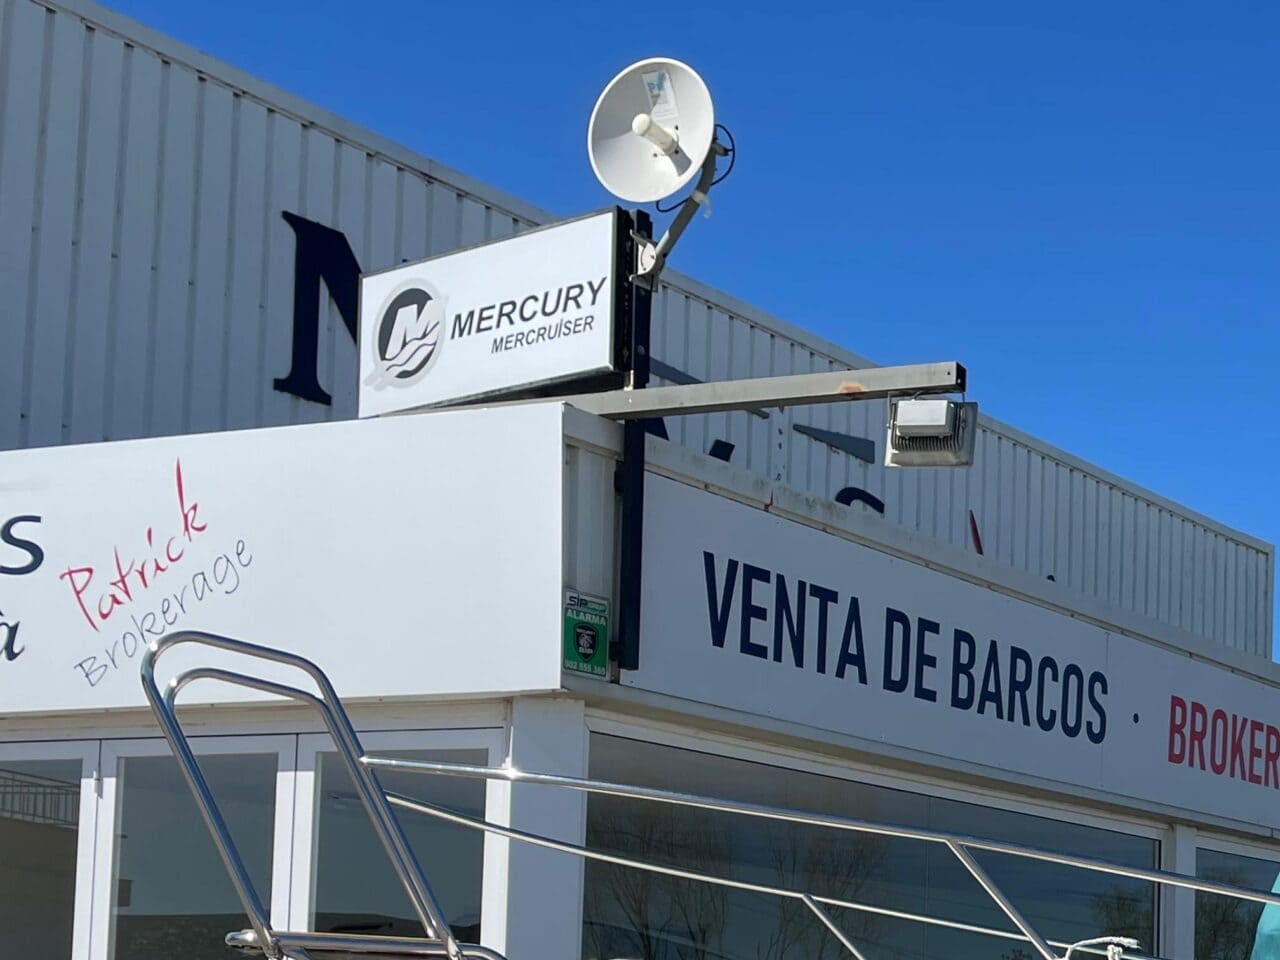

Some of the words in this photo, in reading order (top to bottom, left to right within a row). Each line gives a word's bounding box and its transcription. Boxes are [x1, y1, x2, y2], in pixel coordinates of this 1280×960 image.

[450, 277, 607, 340] MERCURY
[59, 456, 207, 633] Patrick
[73, 539, 253, 687] Brokerage
[566, 608, 606, 625] ALARMA
[703, 550, 867, 685] VENTA
[882, 606, 940, 702] DE
[951, 627, 1109, 744] BARCOS
